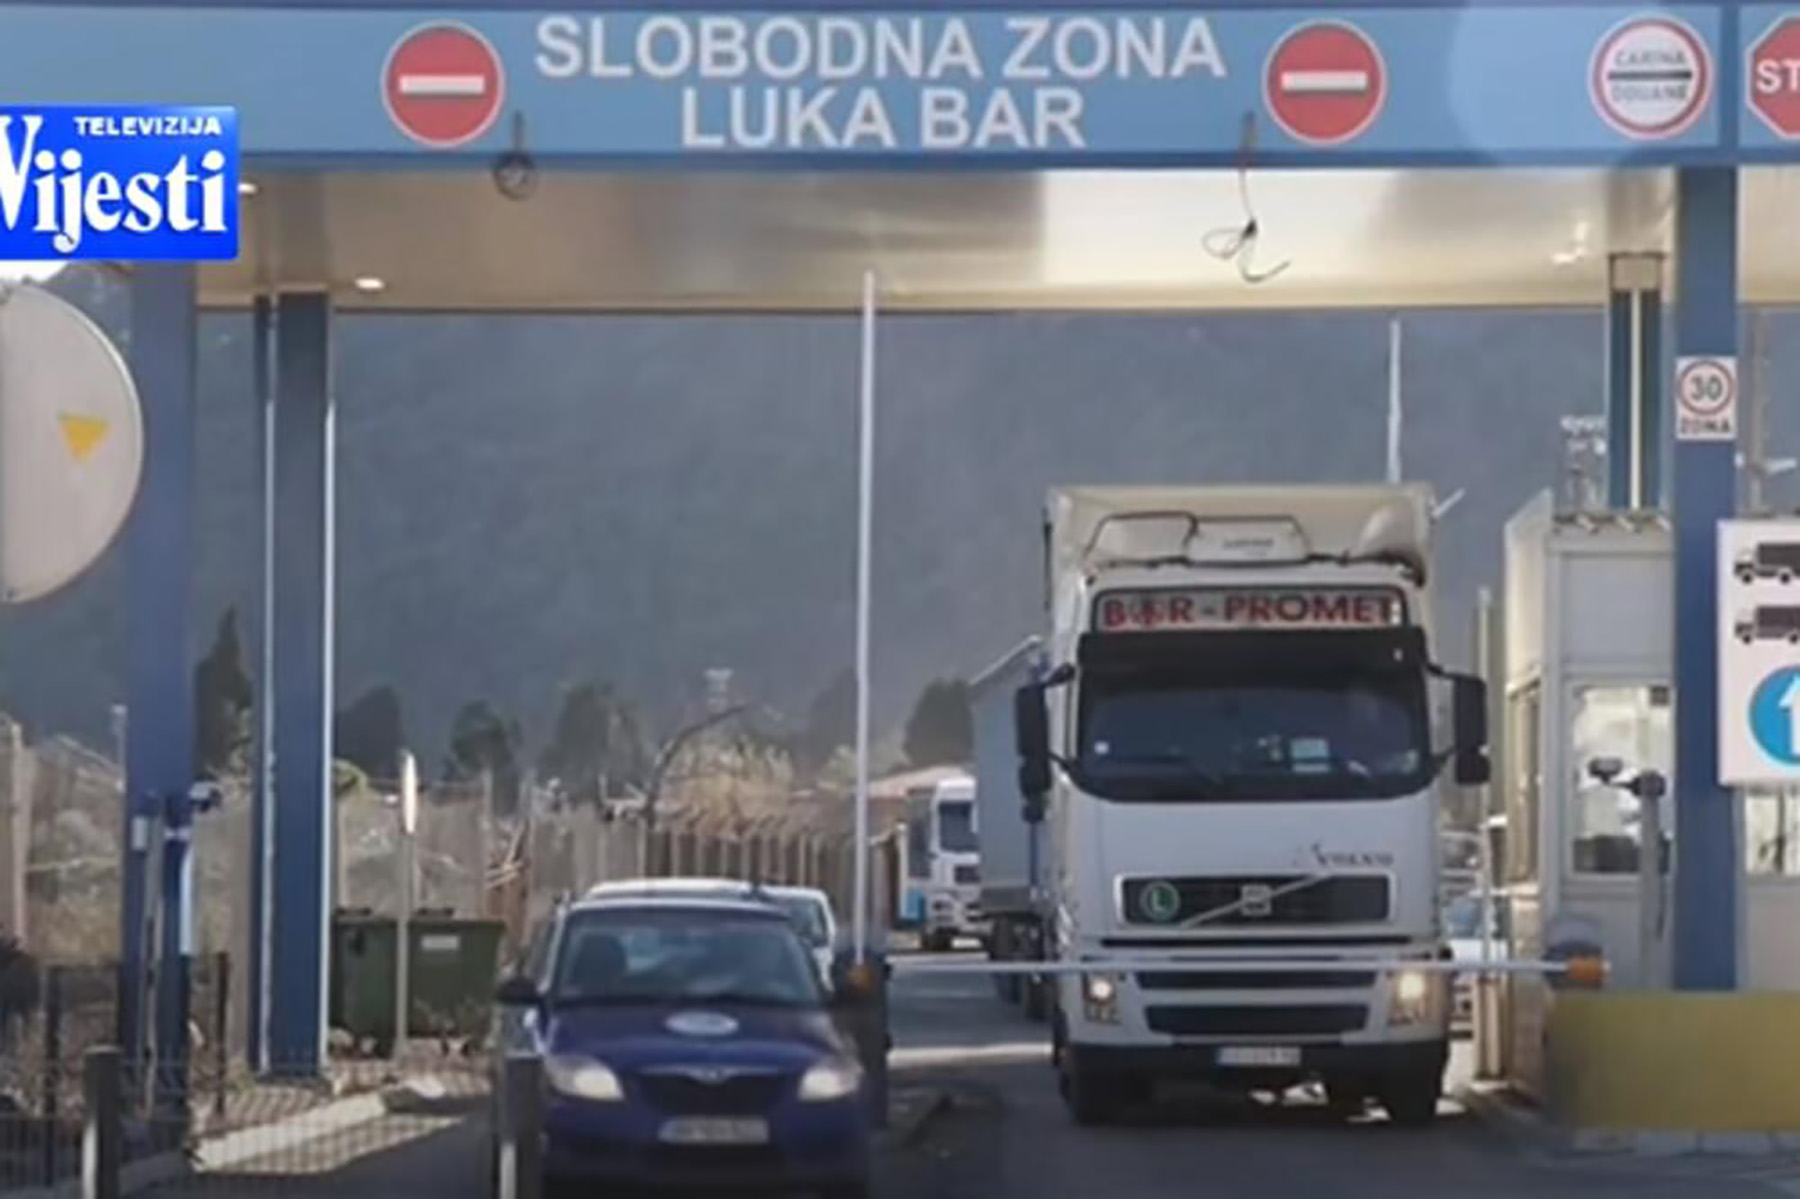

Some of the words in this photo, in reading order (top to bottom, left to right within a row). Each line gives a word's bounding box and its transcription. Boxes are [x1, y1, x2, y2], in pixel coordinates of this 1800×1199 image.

[535, 16, 984, 78] SLOBODNA
[1002, 17, 1227, 78] ZONA
[682, 86, 897, 148] LUKA
[920, 86, 1087, 148] BAR
[1690, 375, 1723, 401] 30
